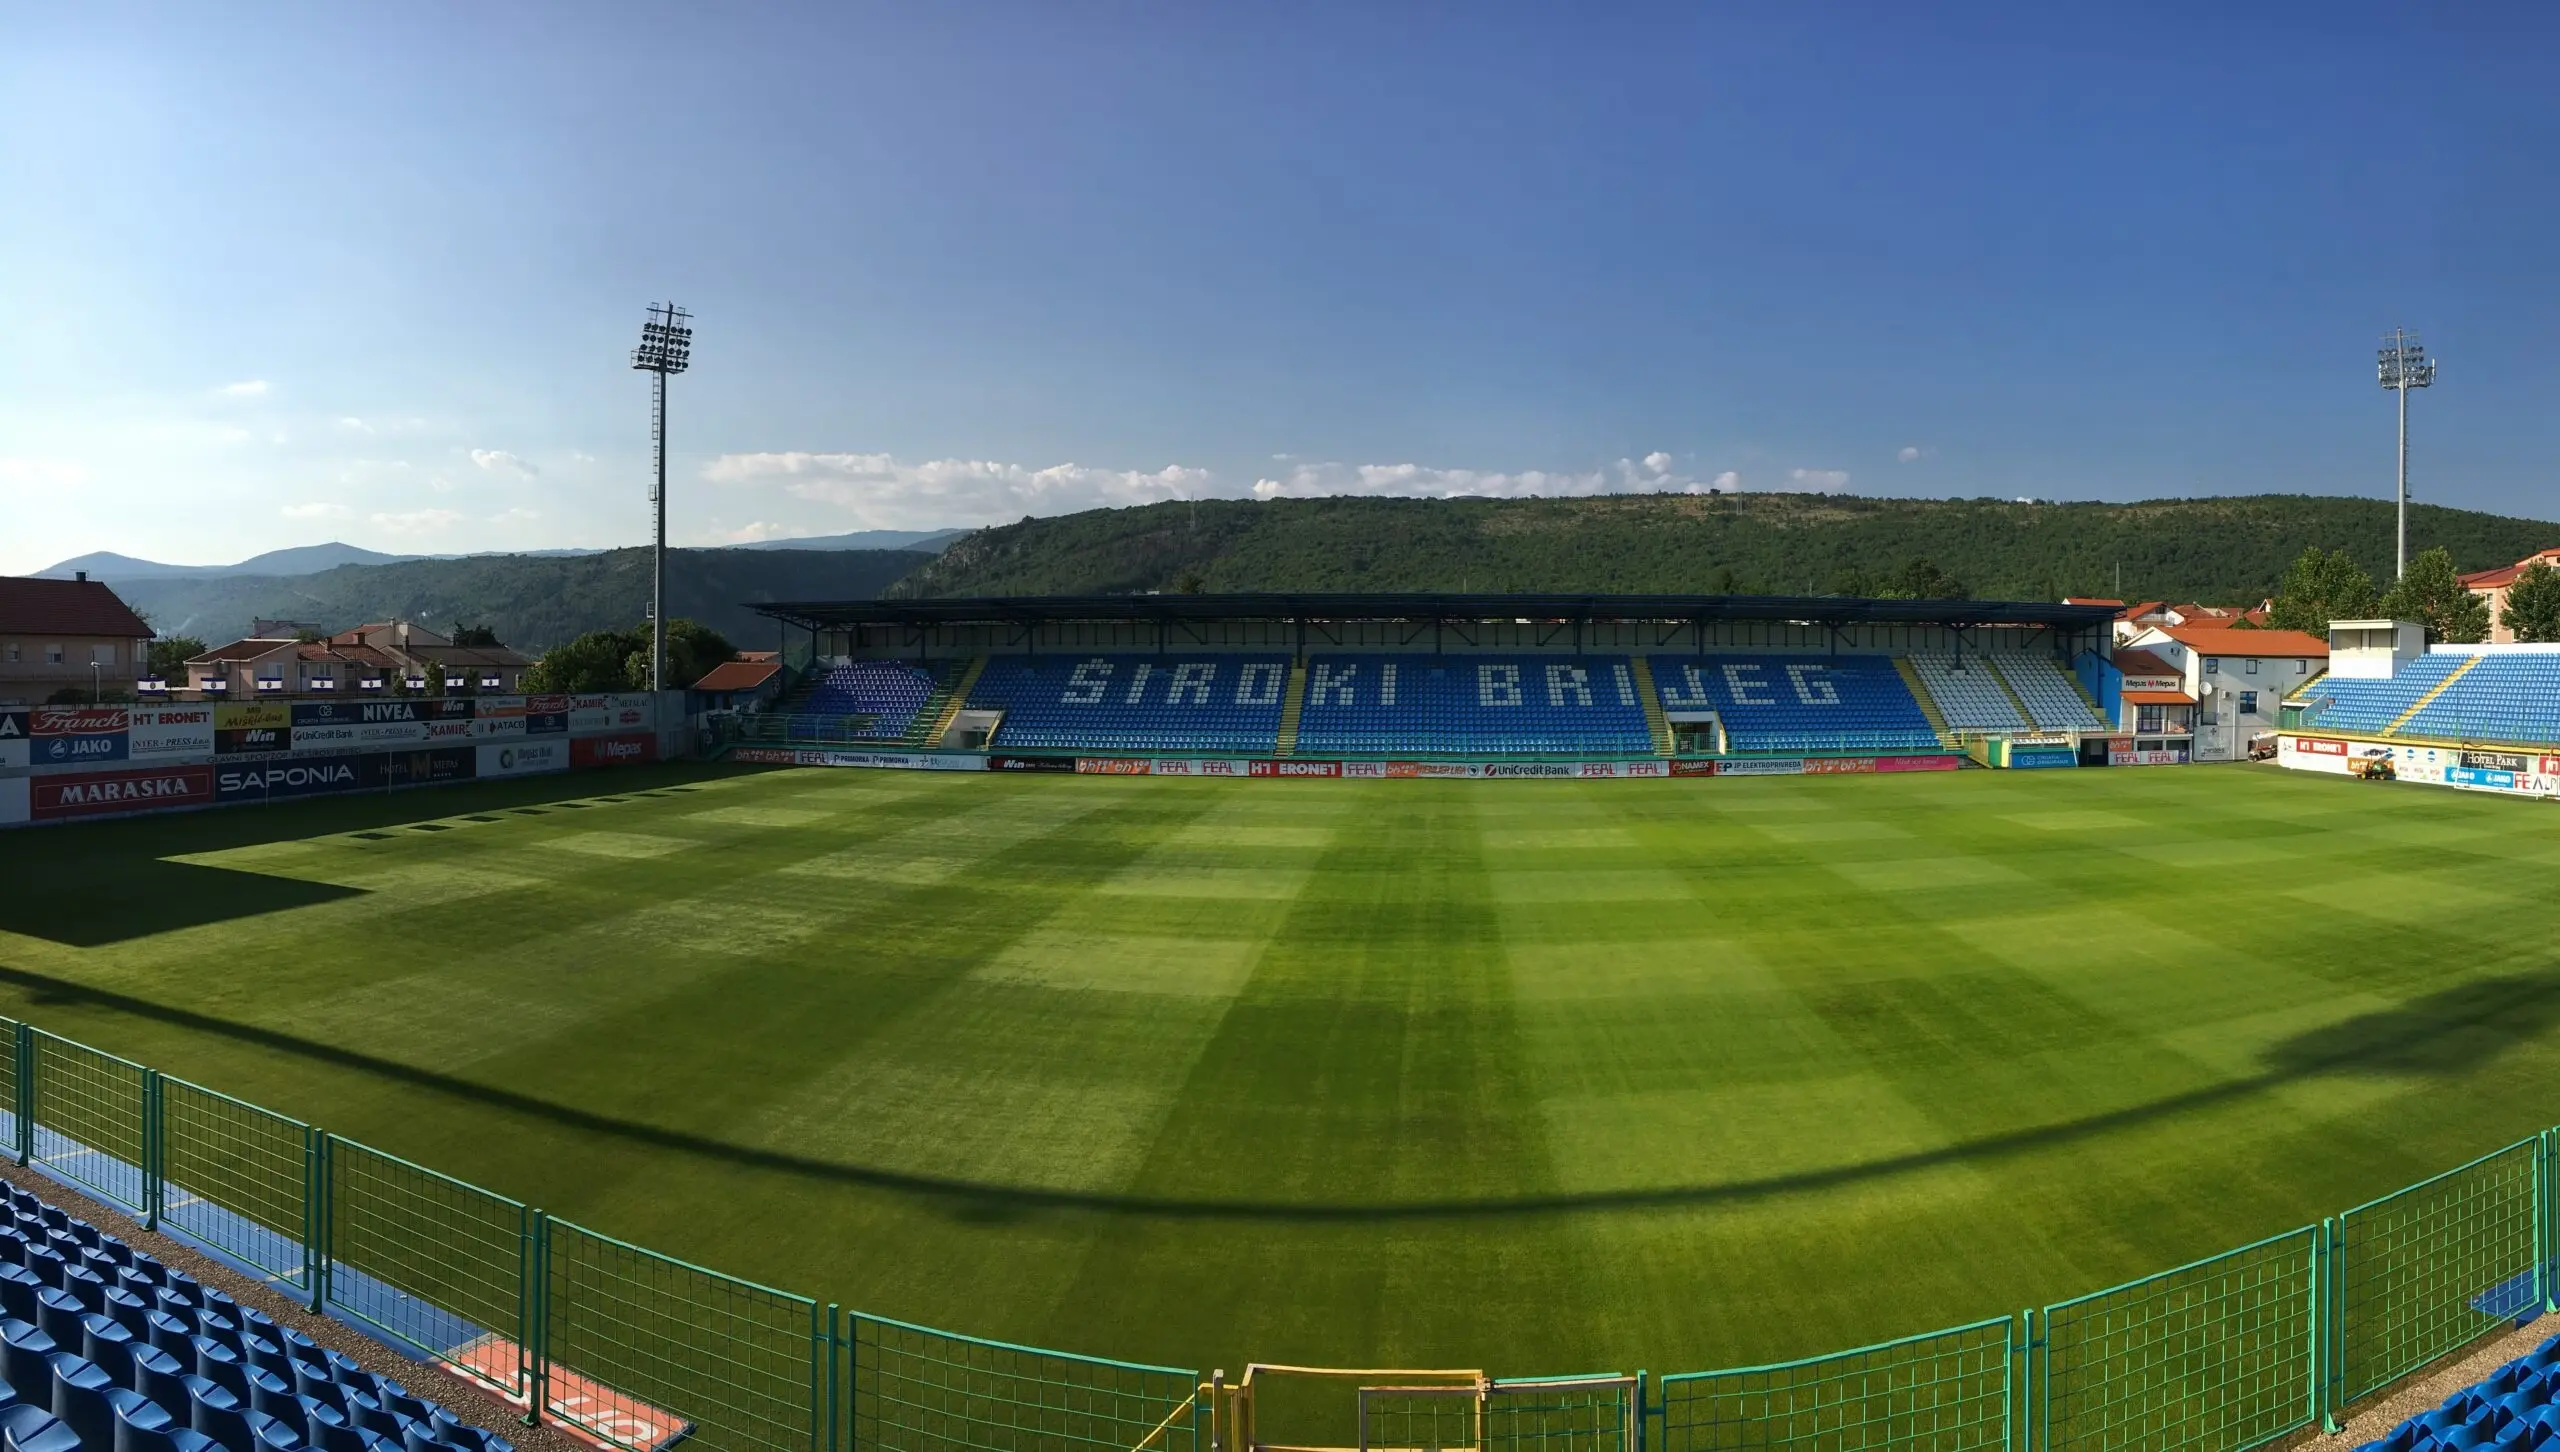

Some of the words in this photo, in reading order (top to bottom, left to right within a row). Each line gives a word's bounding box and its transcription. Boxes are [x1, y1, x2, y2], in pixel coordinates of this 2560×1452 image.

[2126, 679, 2147, 688] Mepas
[2155, 679, 2177, 689] Mepas
[363, 703, 415, 721] NIVEA
[443, 700, 464, 712] Win
[33, 710, 129, 732] Franck
[134, 713, 153, 725] HT
[158, 712, 210, 725] ERONET
[245, 729, 276, 743] Win
[302, 731, 335, 741] UniCredit
[336, 729, 353, 739] Bank
[72, 739, 112, 755] JAKO
[166, 737, 192, 747] PRESS
[607, 742, 642, 760] Mepas
[2115, 752, 2140, 763] FEAL
[1159, 761, 1191, 774] FEAL
[1202, 761, 1234, 774] FEAL
[1251, 762, 1271, 774] HT
[1278, 763, 1337, 775] ERONET
[1347, 763, 1380, 775] FEAL
[1498, 764, 1543, 776] UniCredit
[1544, 764, 1570, 776] Bank
[1583, 763, 1615, 775] FEAL
[1627, 763, 1660, 775] FEAL
[220, 764, 355, 792] SAPONIA
[60, 778, 188, 805] MARASKA
